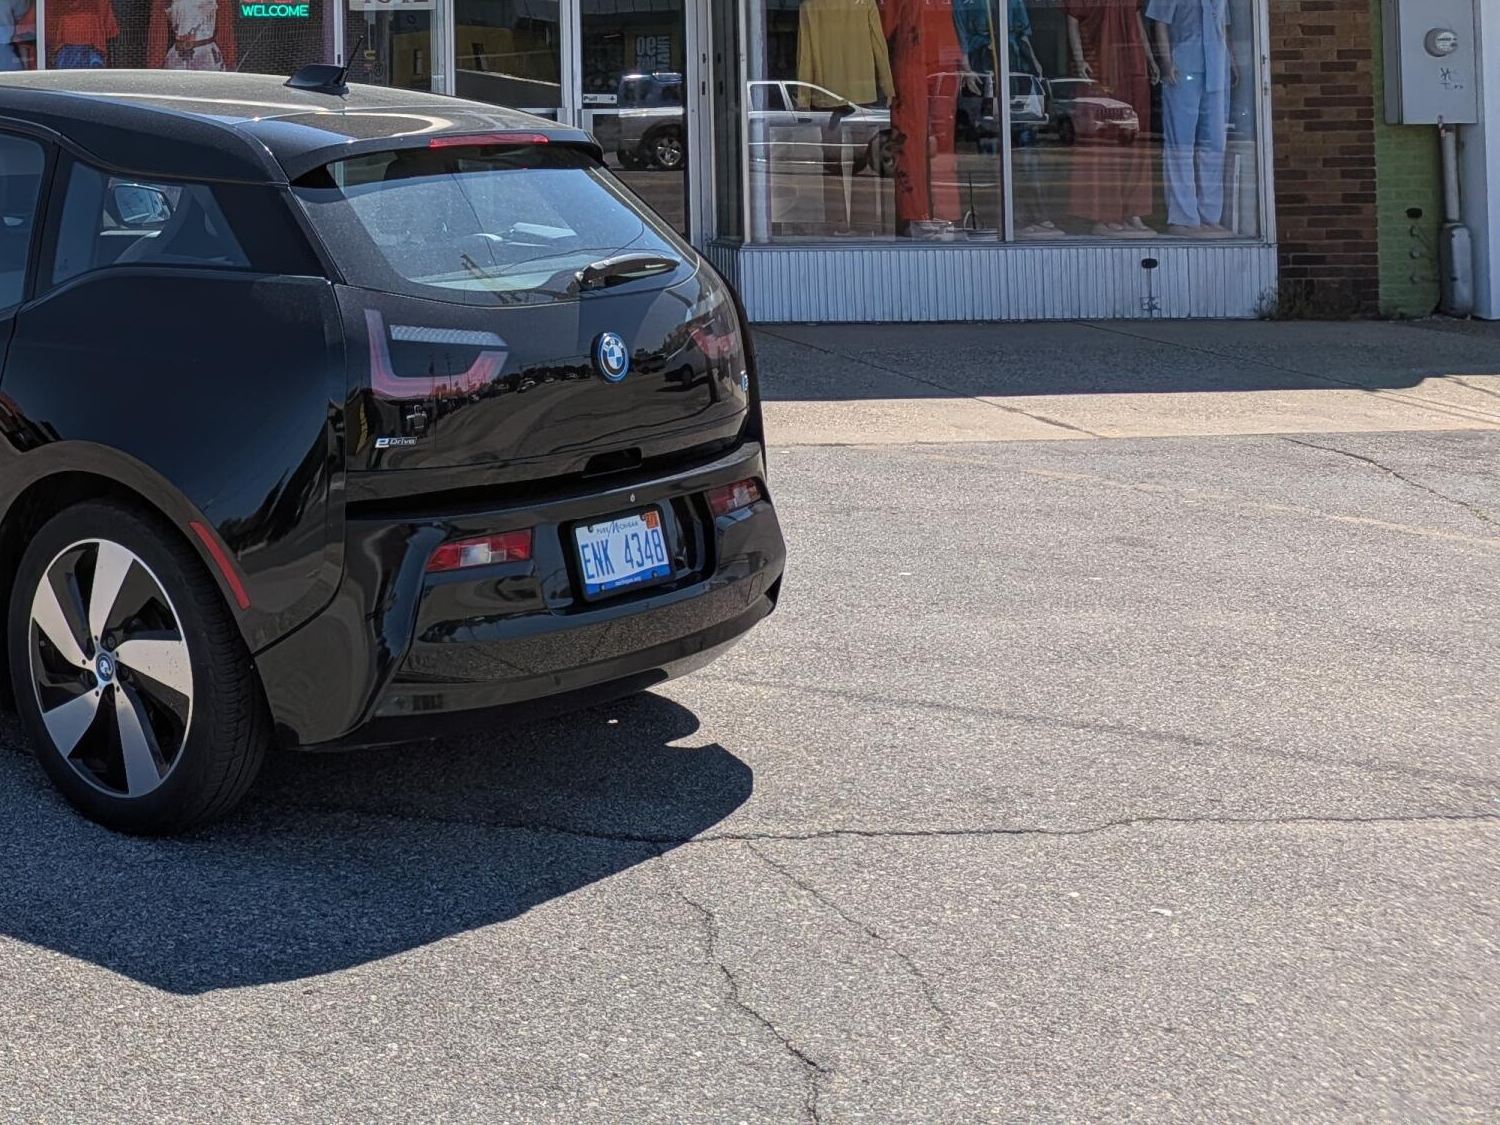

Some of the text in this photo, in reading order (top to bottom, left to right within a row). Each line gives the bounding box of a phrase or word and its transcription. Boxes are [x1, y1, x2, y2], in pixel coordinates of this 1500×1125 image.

[241, 4, 309, 17] WELCOME
[580, 528, 665, 580] ENK 4348
